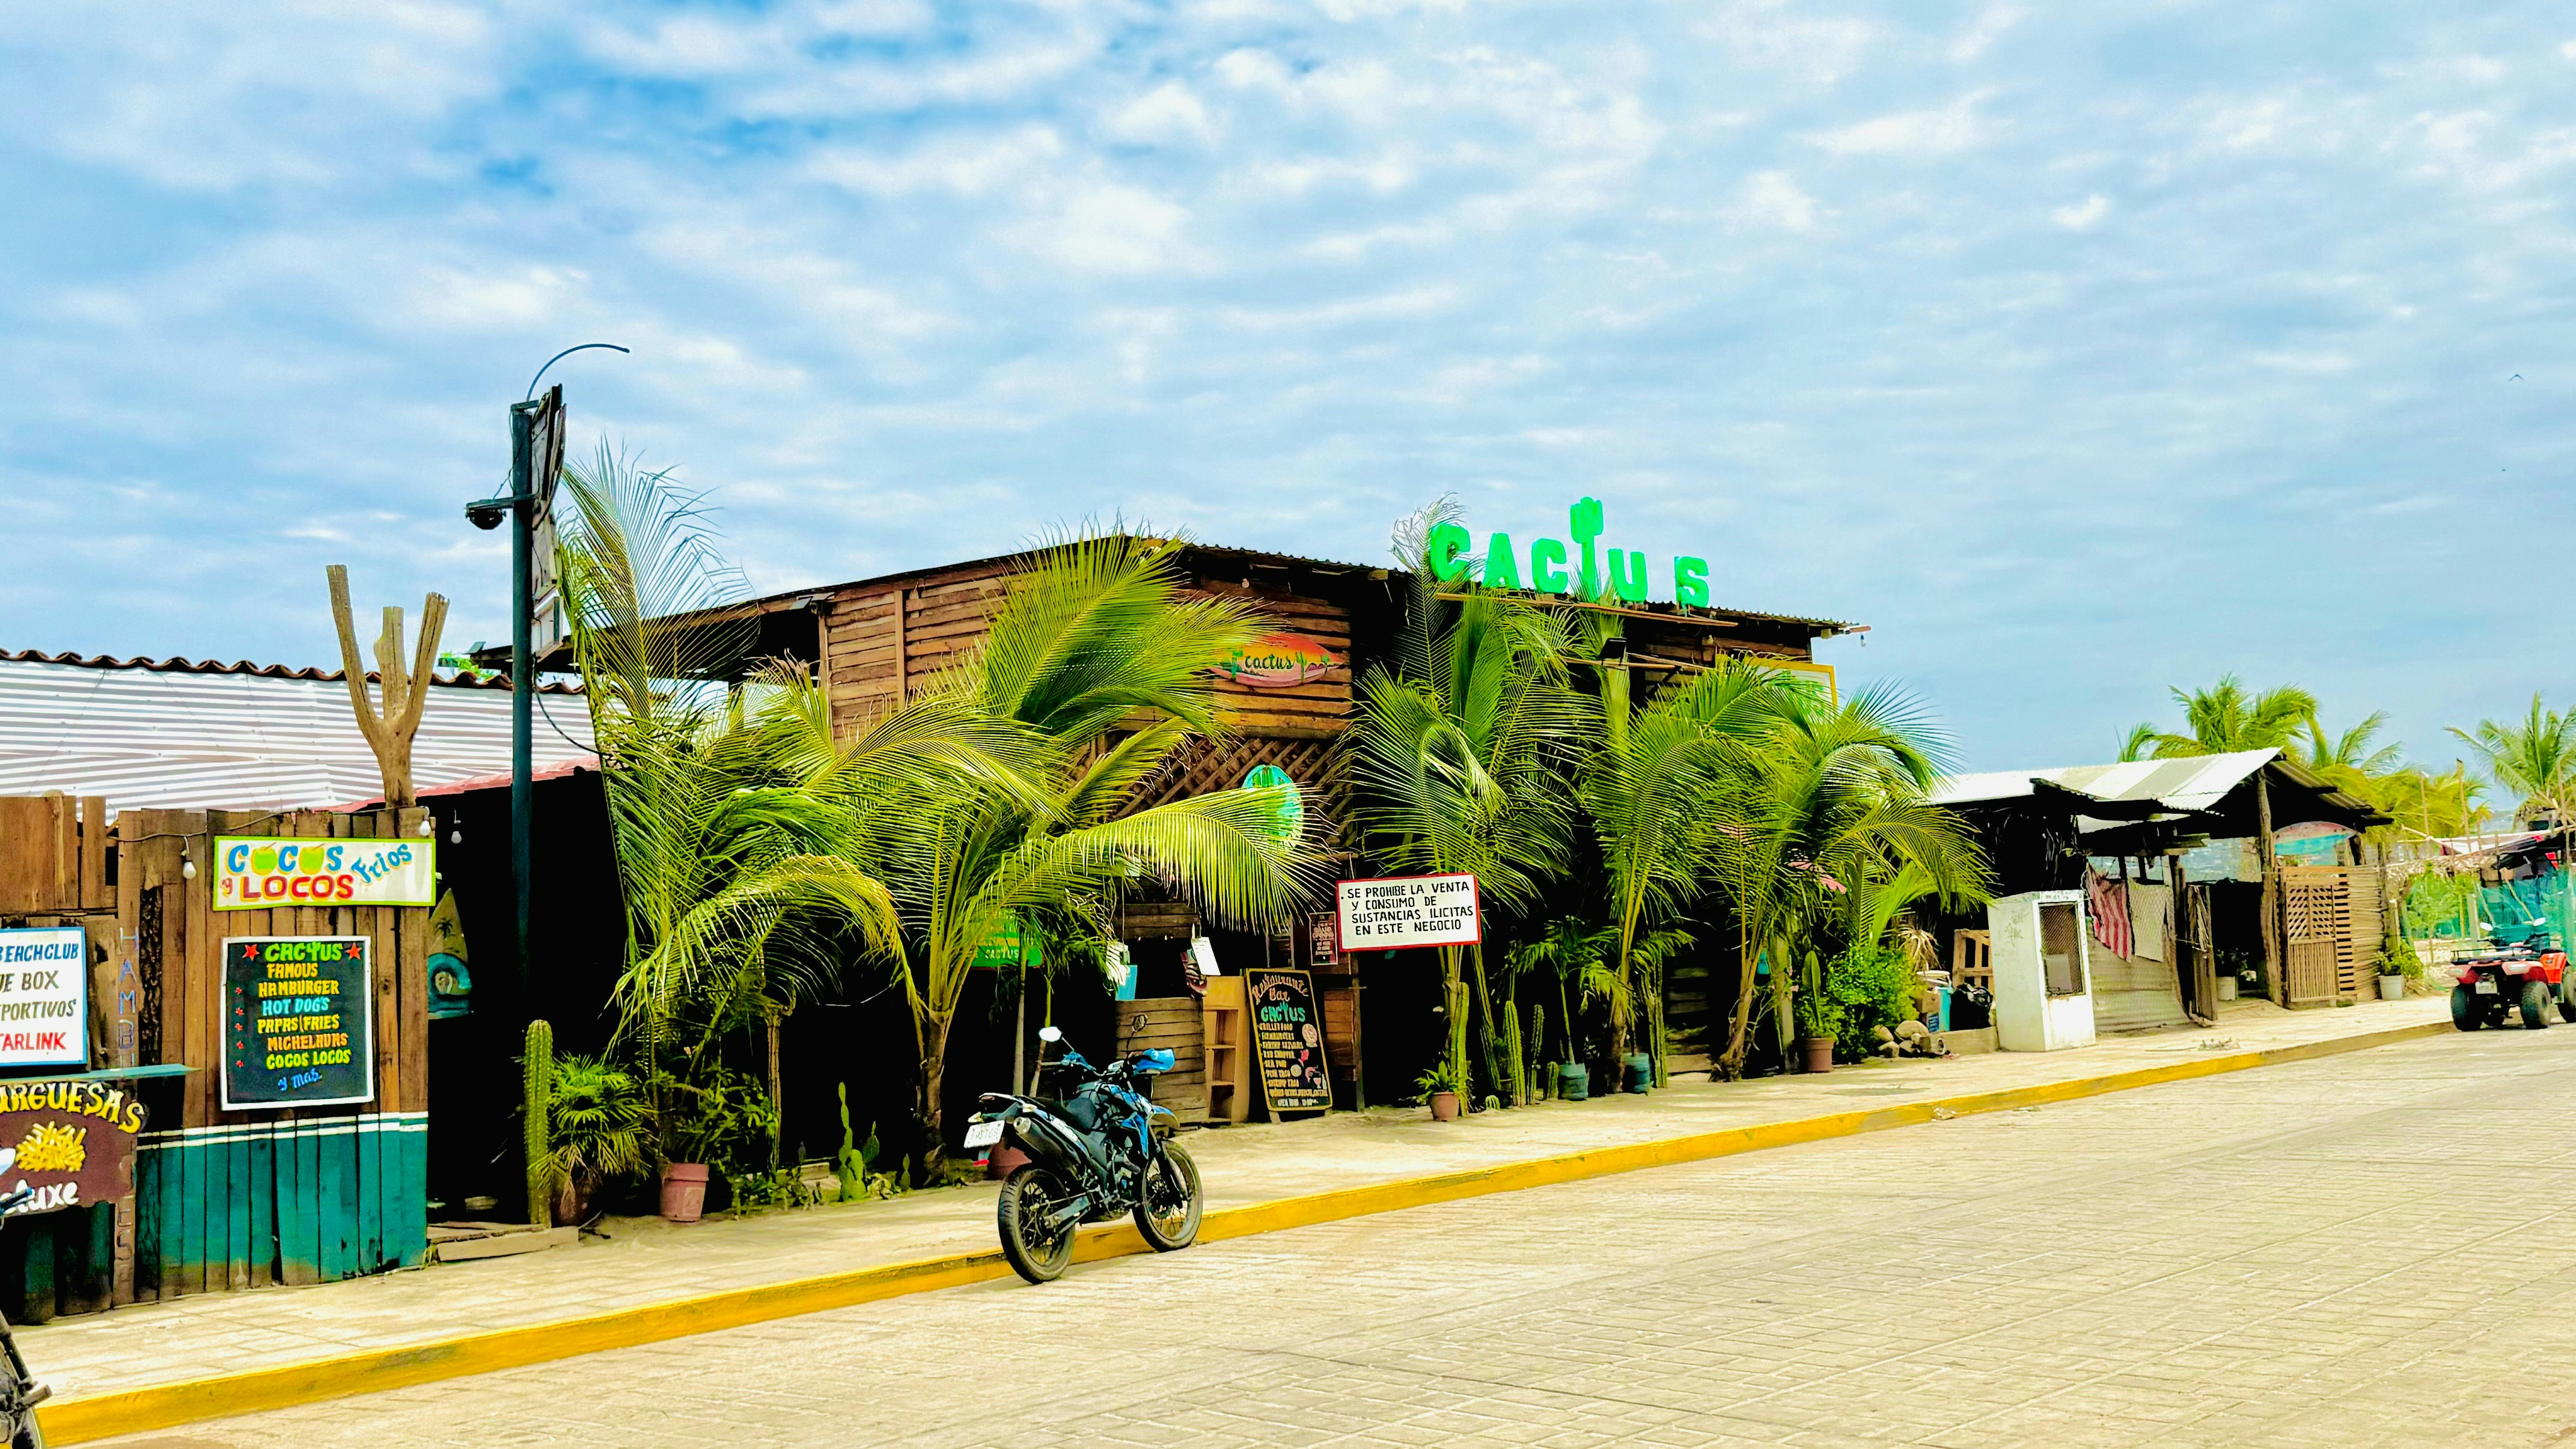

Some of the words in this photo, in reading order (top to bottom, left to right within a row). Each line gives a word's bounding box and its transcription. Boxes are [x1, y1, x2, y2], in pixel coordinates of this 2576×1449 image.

[1430, 496, 1710, 608] CACTUS
[1245, 653, 1295, 670] cactus
[240, 874, 355, 901] LOCOS
[1348, 888, 1361, 898] SE
[1366, 885, 1406, 898] PROHIBE
[1411, 884, 1424, 895] LA
[1432, 881, 1470, 893] VENTA
[1366, 897, 1415, 910] CONSUMO
[1424, 895, 1436, 906] DE
[1352, 909, 1421, 923] SUSTANCIAS
[1430, 906, 1473, 918] ILICITAS
[1355, 925, 1370, 935] EN
[1378, 923, 1403, 935] ESTE
[1414, 919, 1461, 932] NEGOCIO
[264, 942, 343, 962] CACTUS
[266, 963, 319, 978] FAMOUS
[22, 969, 59, 991] BOX
[258, 980, 340, 998] HAMBURGER
[0, 998, 77, 1021] PORTIVOS
[262, 998, 291, 1016] HOT
[1261, 1001, 1305, 1022] CACTUS
[257, 1017, 299, 1034] PAPAS
[266, 1052, 310, 1070] COCOS
[313, 1049, 352, 1066] LOCOS
